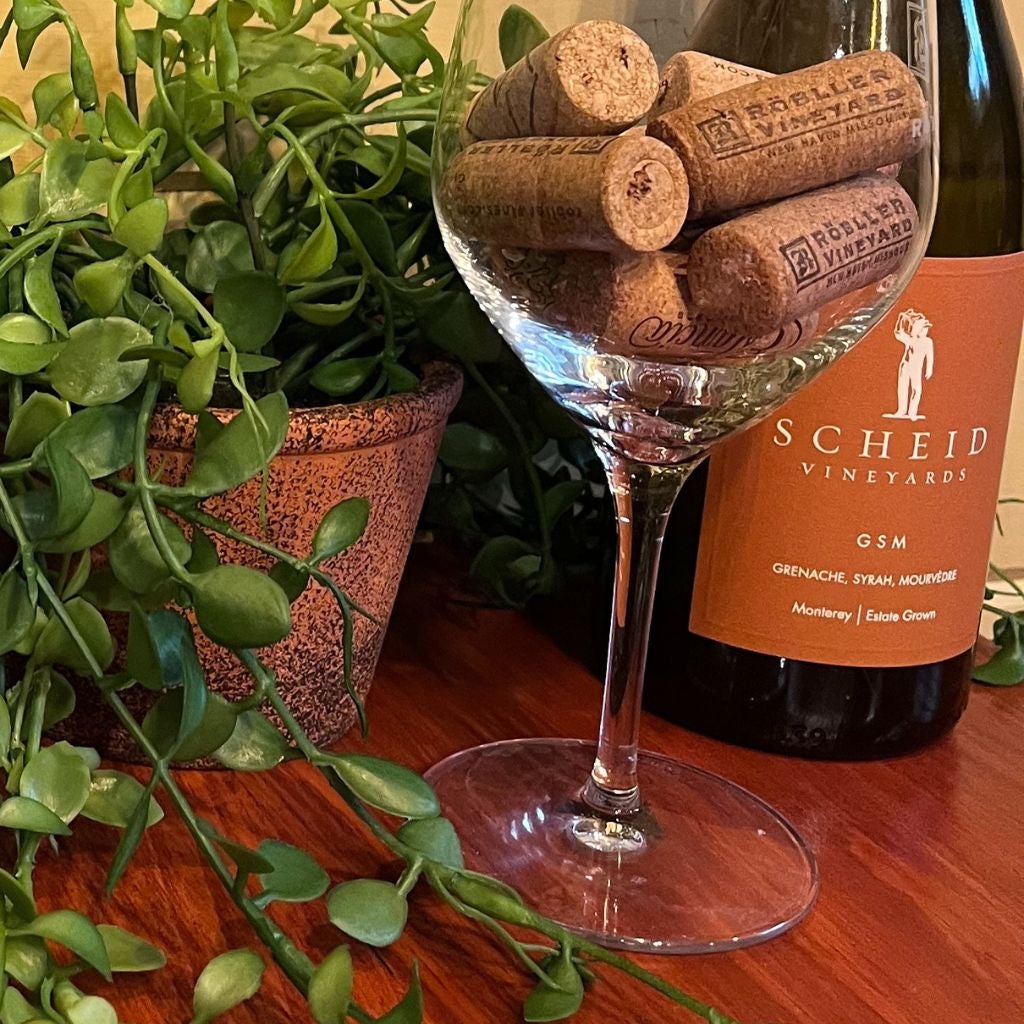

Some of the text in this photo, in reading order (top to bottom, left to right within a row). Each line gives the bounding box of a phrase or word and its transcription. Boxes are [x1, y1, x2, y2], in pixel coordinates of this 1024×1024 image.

[743, 68, 892, 120] RÖBLLER
[755, 87, 907, 138] VINEYARD
[810, 198, 907, 249] RÖBLLER
[823, 218, 912, 268] VINEYARD
[773, 418, 988, 461] SCHEID
[801, 461, 967, 485] VINEYARDS
[772, 562, 958, 588] GRENACHE, SYRAH, MOURVÈDRE
[791, 600, 937, 623] Monterey Estate Grown
